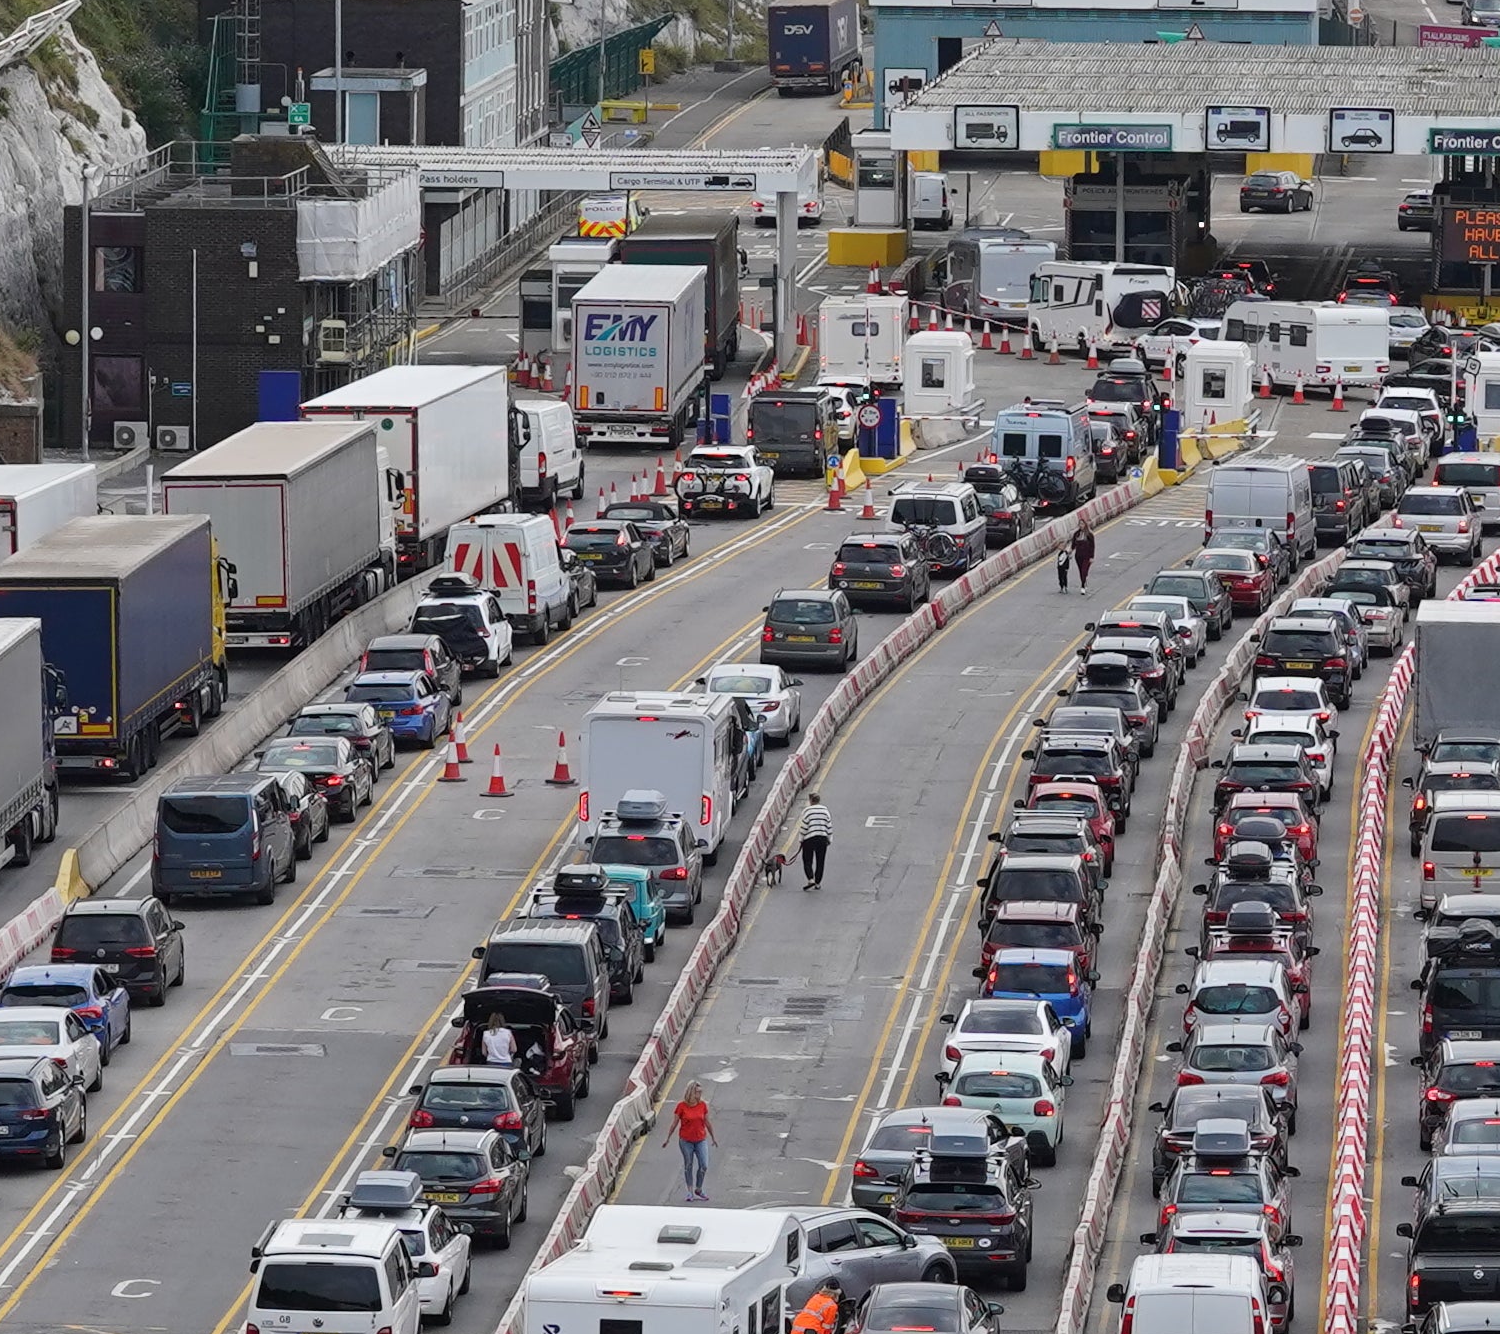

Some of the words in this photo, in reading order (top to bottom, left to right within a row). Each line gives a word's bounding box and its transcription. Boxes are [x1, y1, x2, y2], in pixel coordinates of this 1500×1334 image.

[783, 24, 814, 36] DSV
[963, 110, 975, 118] ALL
[1058, 131, 1112, 145] Frontier
[1115, 131, 1168, 145] Control
[1434, 135, 1489, 149] Frontier
[419, 174, 438, 185] Pass
[439, 174, 478, 185] holders
[617, 176, 640, 188] Cargo
[641, 176, 675, 186] Terminal
[676, 177, 682, 186] &
[684, 177, 701, 186] UTP
[1469, 245, 1500, 260] ALL
[584, 314, 659, 342] EMY
[585, 346, 657, 358] LOGISTICS
[111, 1278, 162, 1299] C
[279, 1315, 291, 1324] GB
